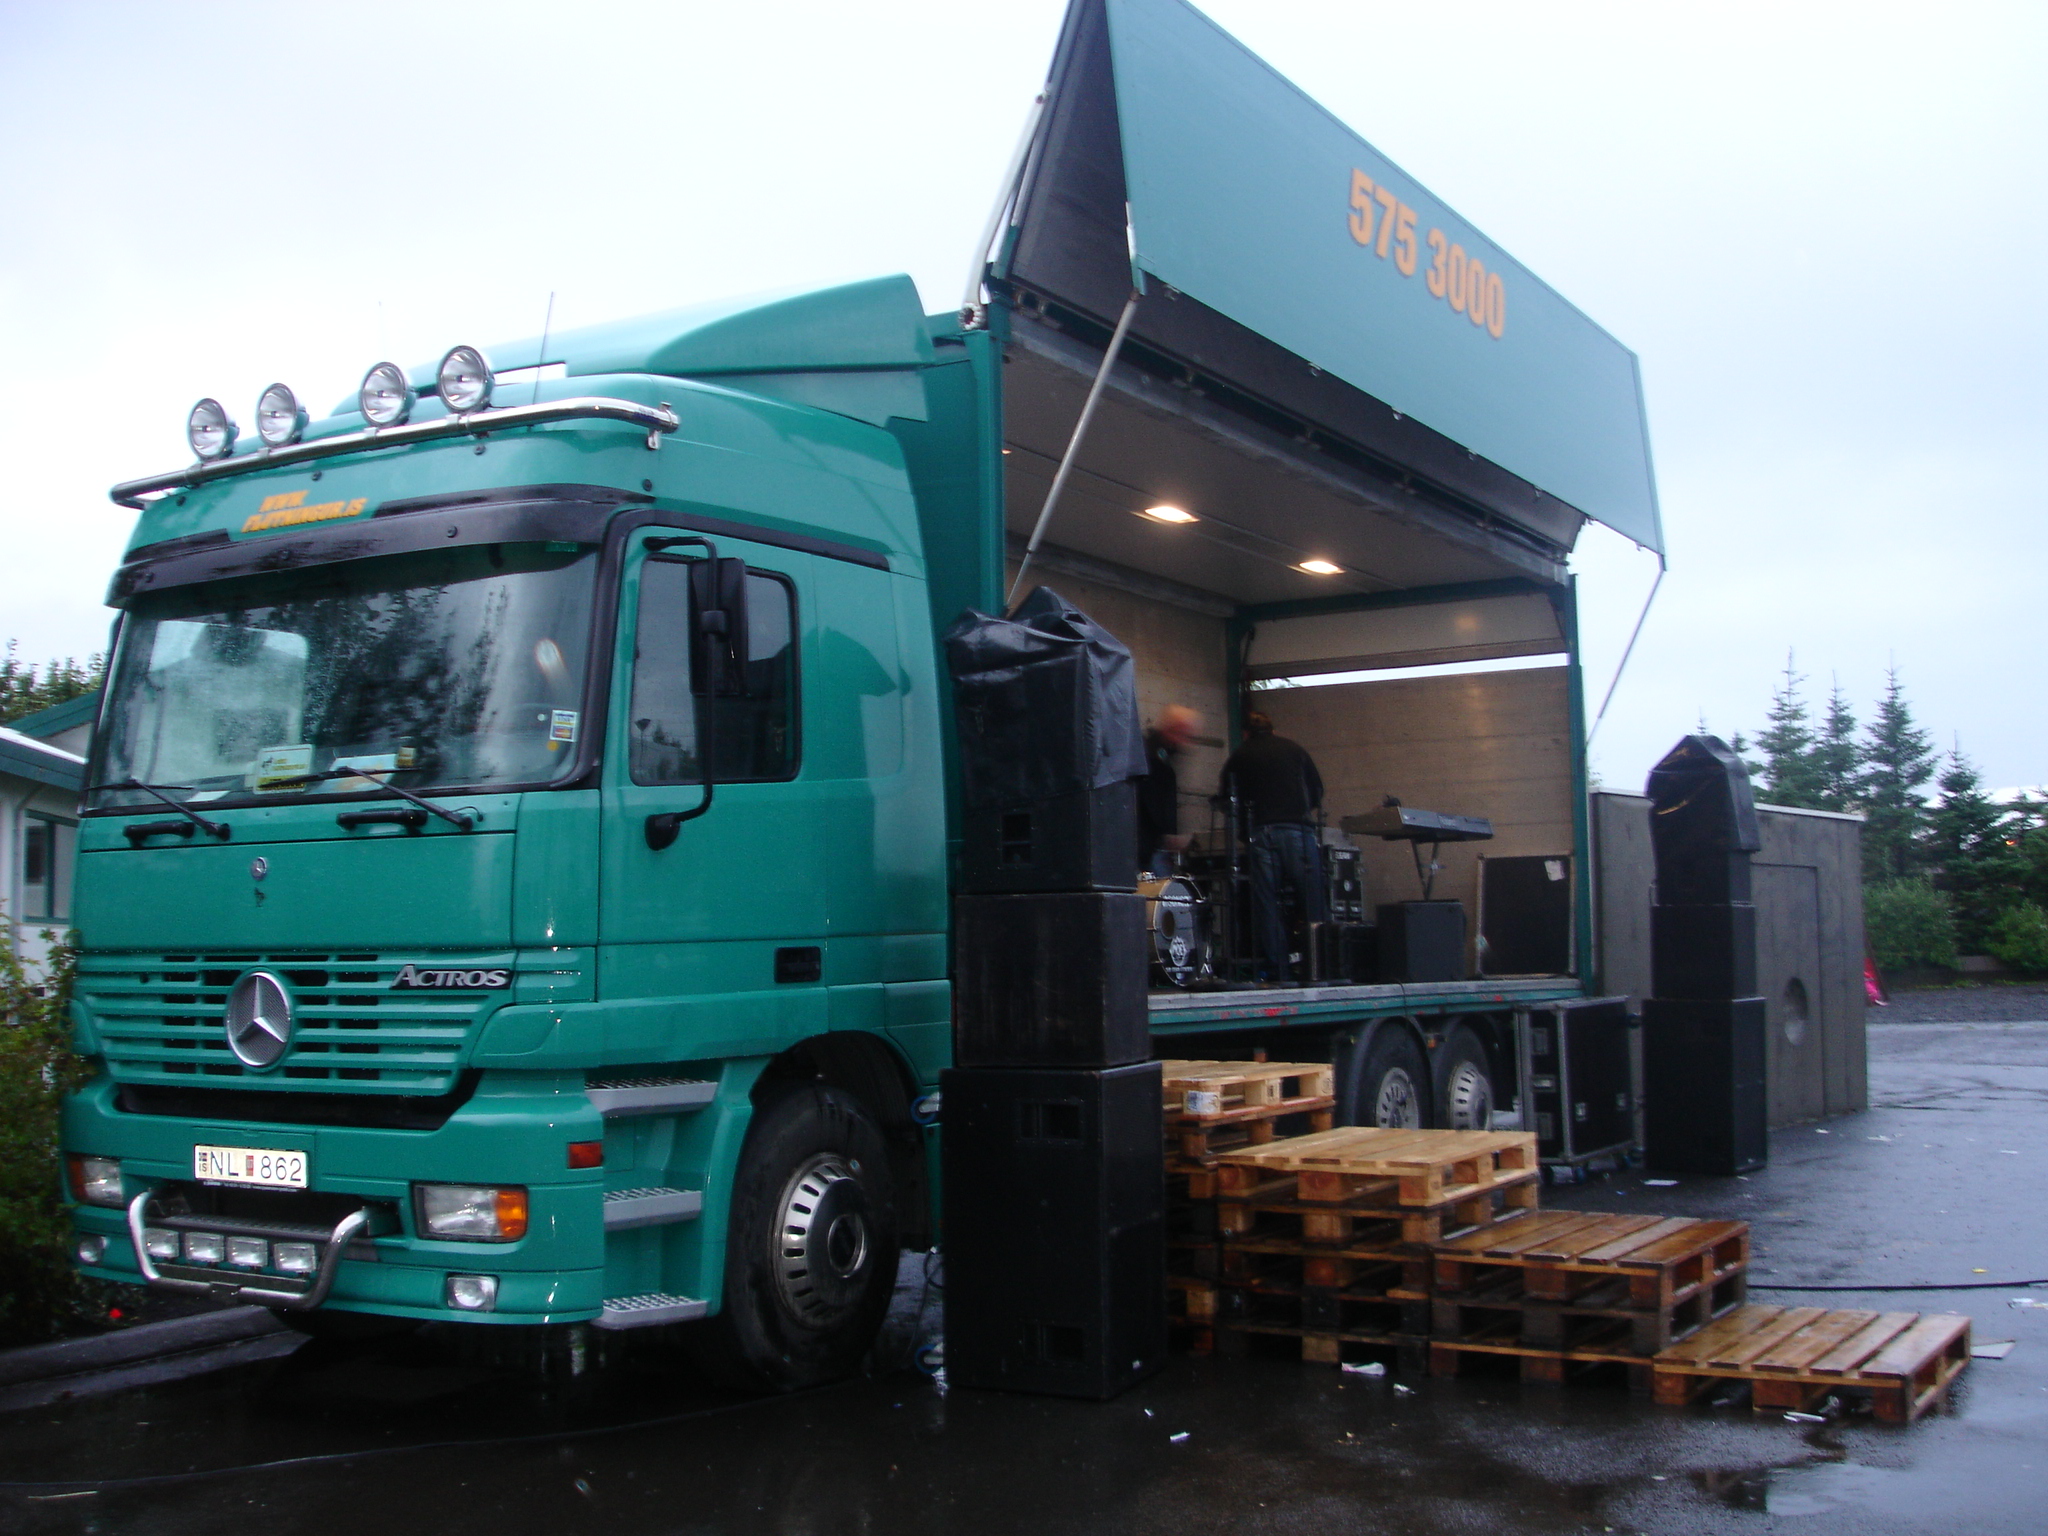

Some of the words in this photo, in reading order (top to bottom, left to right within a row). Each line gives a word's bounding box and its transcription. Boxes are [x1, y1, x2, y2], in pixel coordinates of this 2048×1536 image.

[1347, 168, 1418, 278] 575
[1425, 227, 1505, 340] 3000
[392, 964, 508, 987] ACTROS
[198, 1161, 208, 1173] IS
[210, 1151, 239, 1177] NL
[260, 1155, 302, 1182] 862
